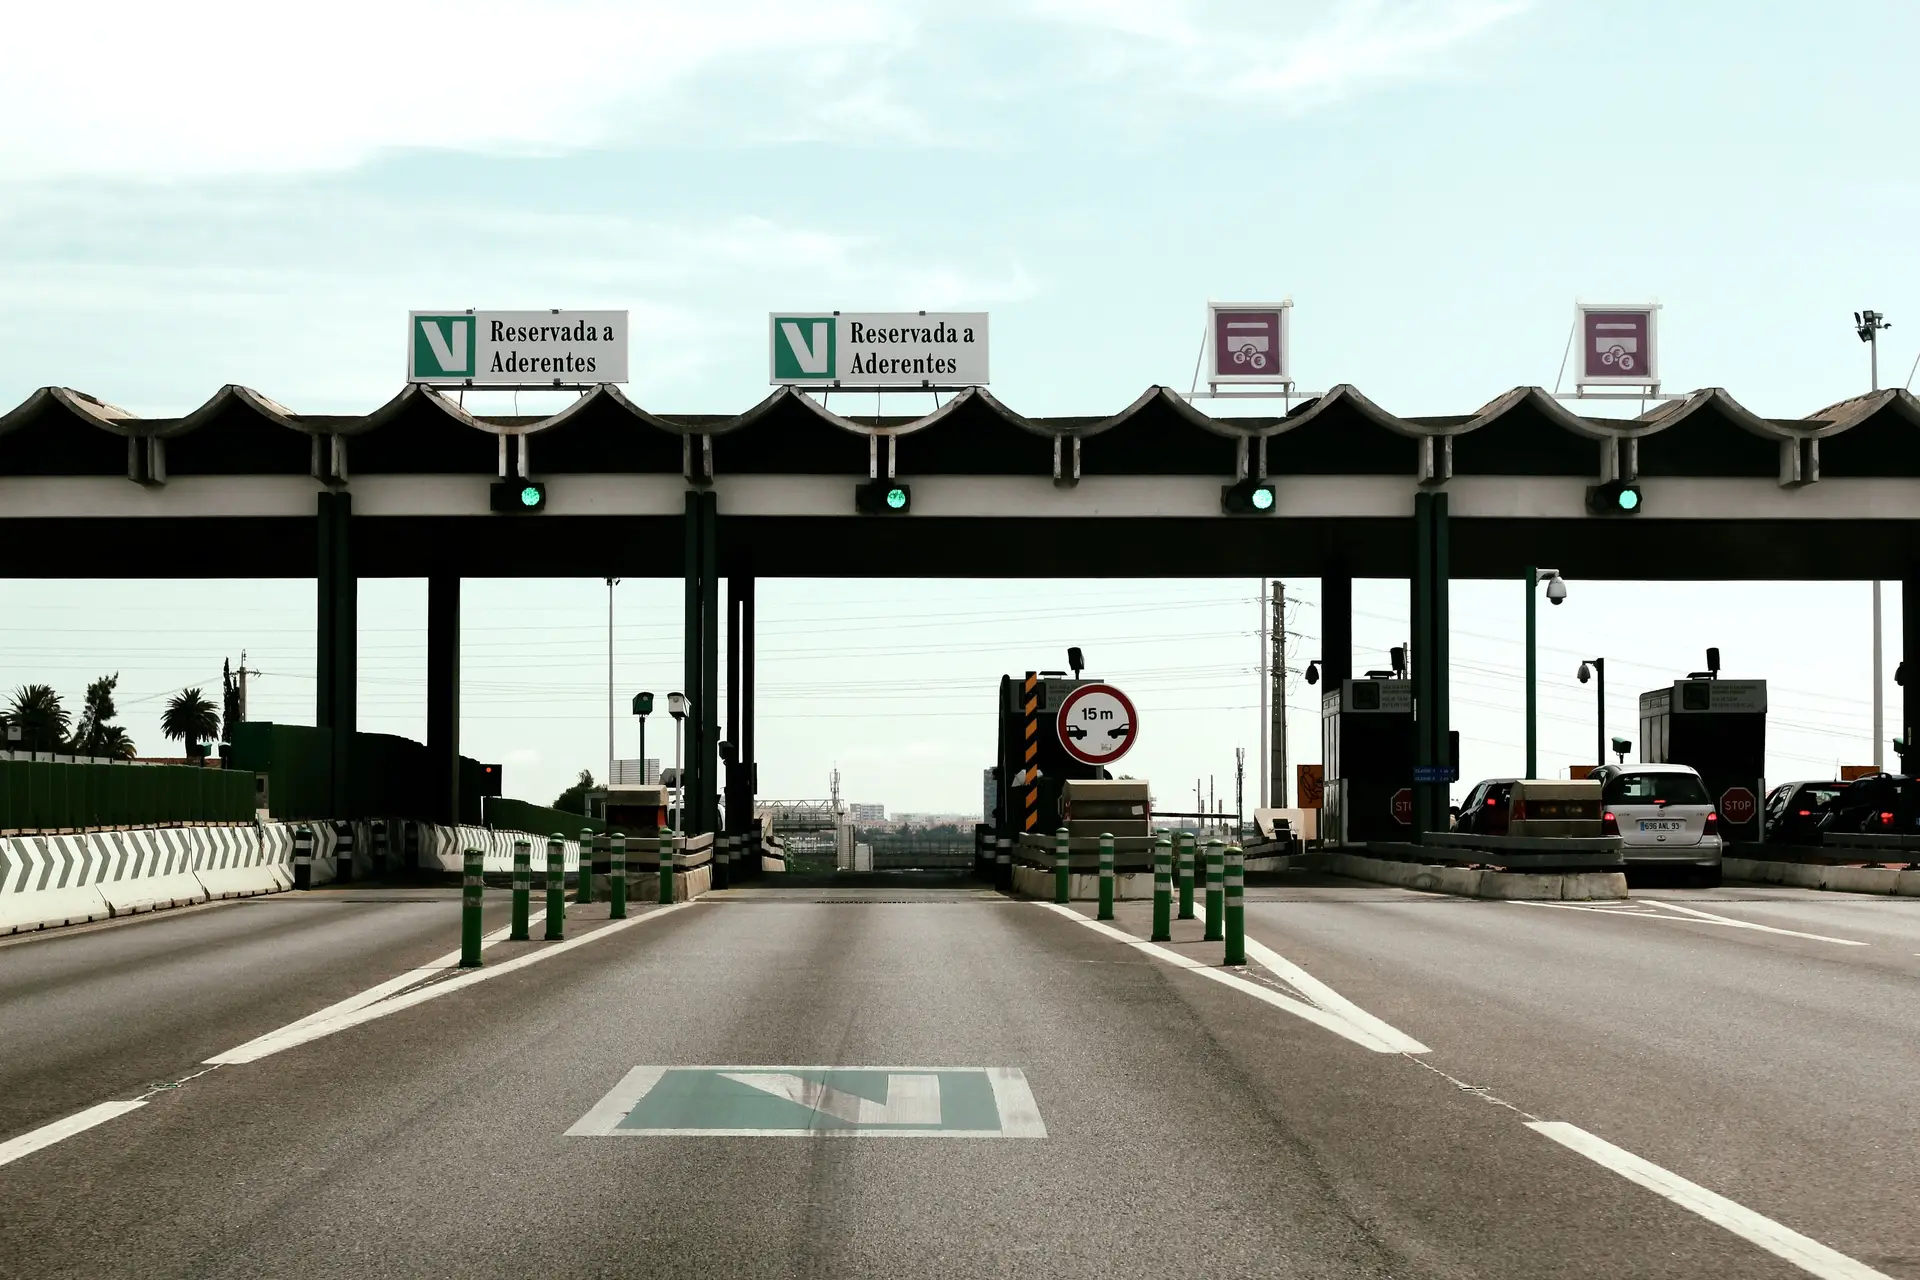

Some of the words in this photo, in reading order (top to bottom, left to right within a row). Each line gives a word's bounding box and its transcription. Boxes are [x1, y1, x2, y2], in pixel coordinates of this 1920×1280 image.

[490, 320, 598, 342] Reservada
[603, 326, 614, 342] a
[850, 321, 958, 343] Reservada
[963, 328, 975, 343] a
[490, 350, 597, 373] Aderentes
[850, 352, 957, 374] Aderentes
[1081, 707, 1098, 721] 15
[1100, 710, 1114, 720] m
[1395, 801, 1412, 812] STO
[1724, 800, 1752, 811] STOP
[1658, 822, 1670, 830] ANL
[1671, 822, 1680, 830] 93
